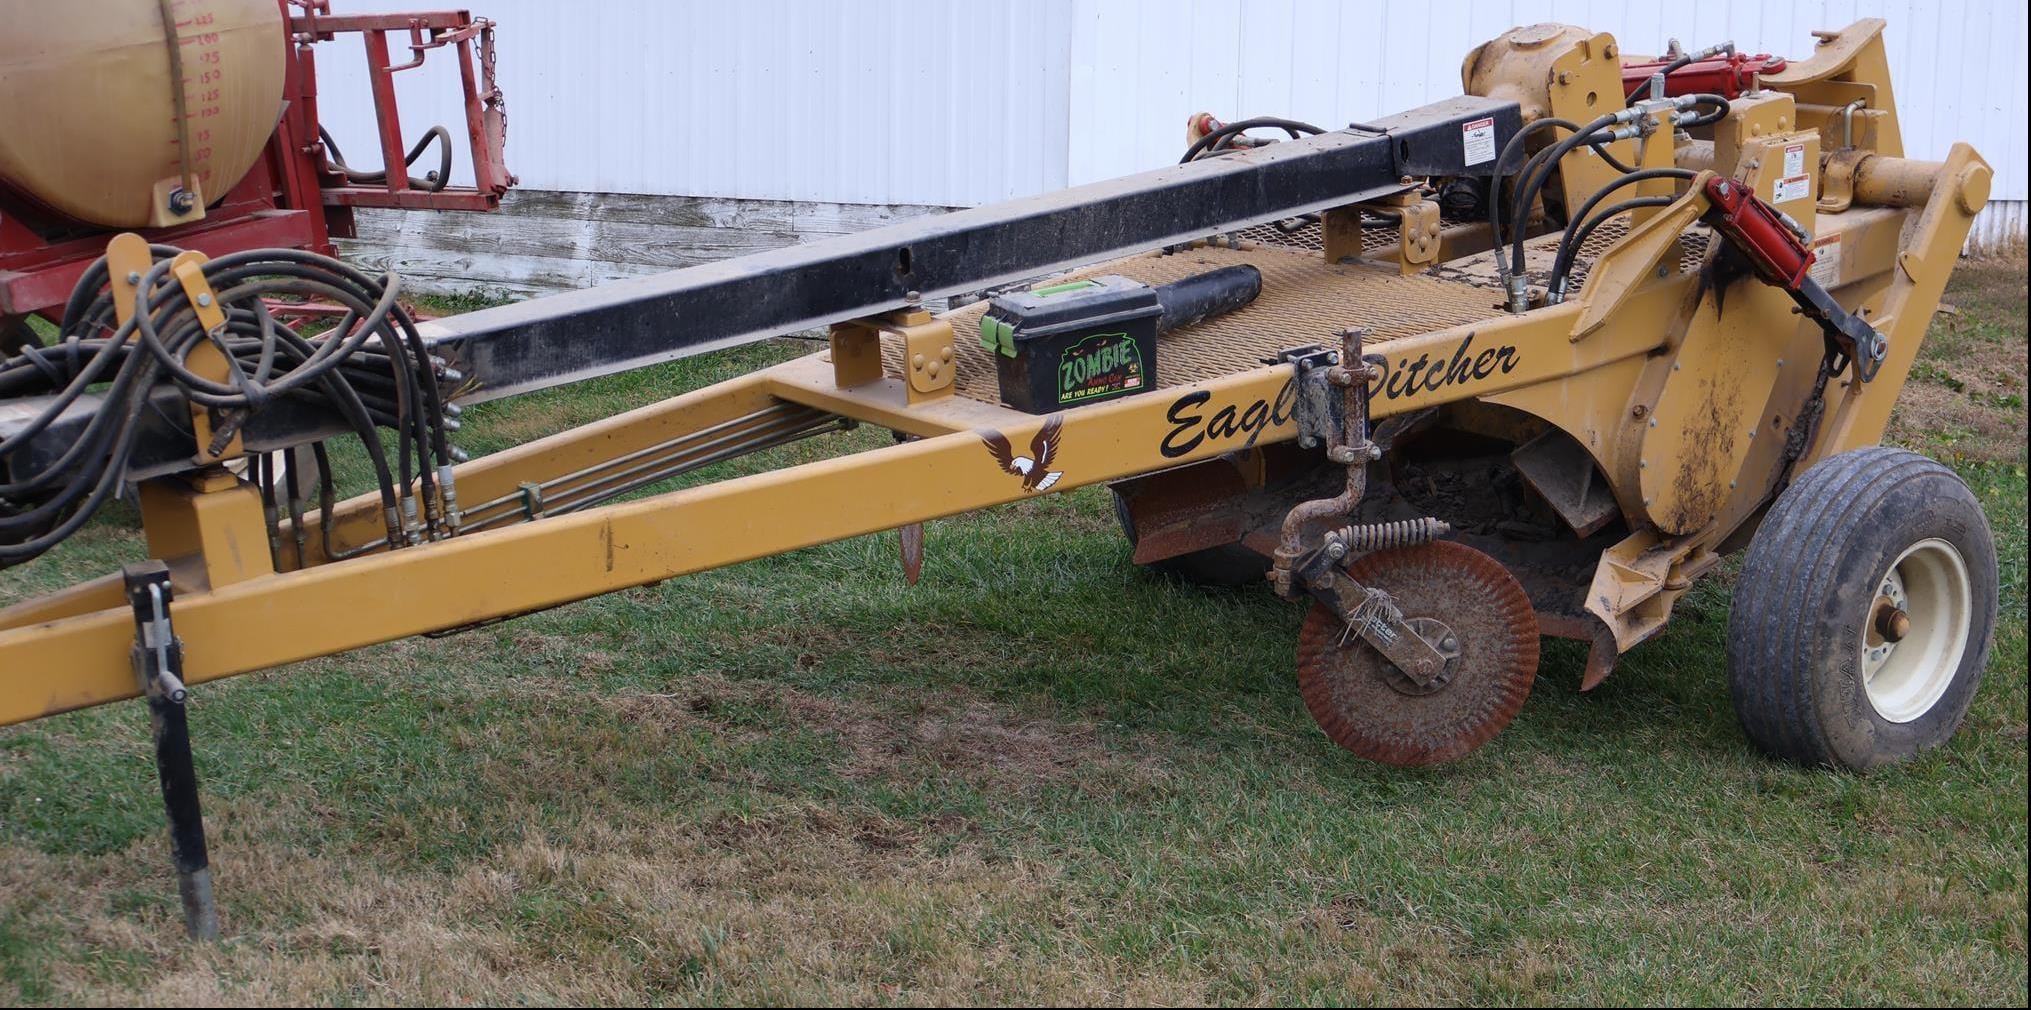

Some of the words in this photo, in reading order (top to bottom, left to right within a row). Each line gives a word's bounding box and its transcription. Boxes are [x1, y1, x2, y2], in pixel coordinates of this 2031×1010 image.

[1062, 340, 1132, 390] ZOMBIE
[1061, 391, 1073, 400] ARE
[1074, 388, 1086, 397] YOU
[1087, 385, 1109, 396] READY!
[1160, 376, 1298, 458] Eagl
